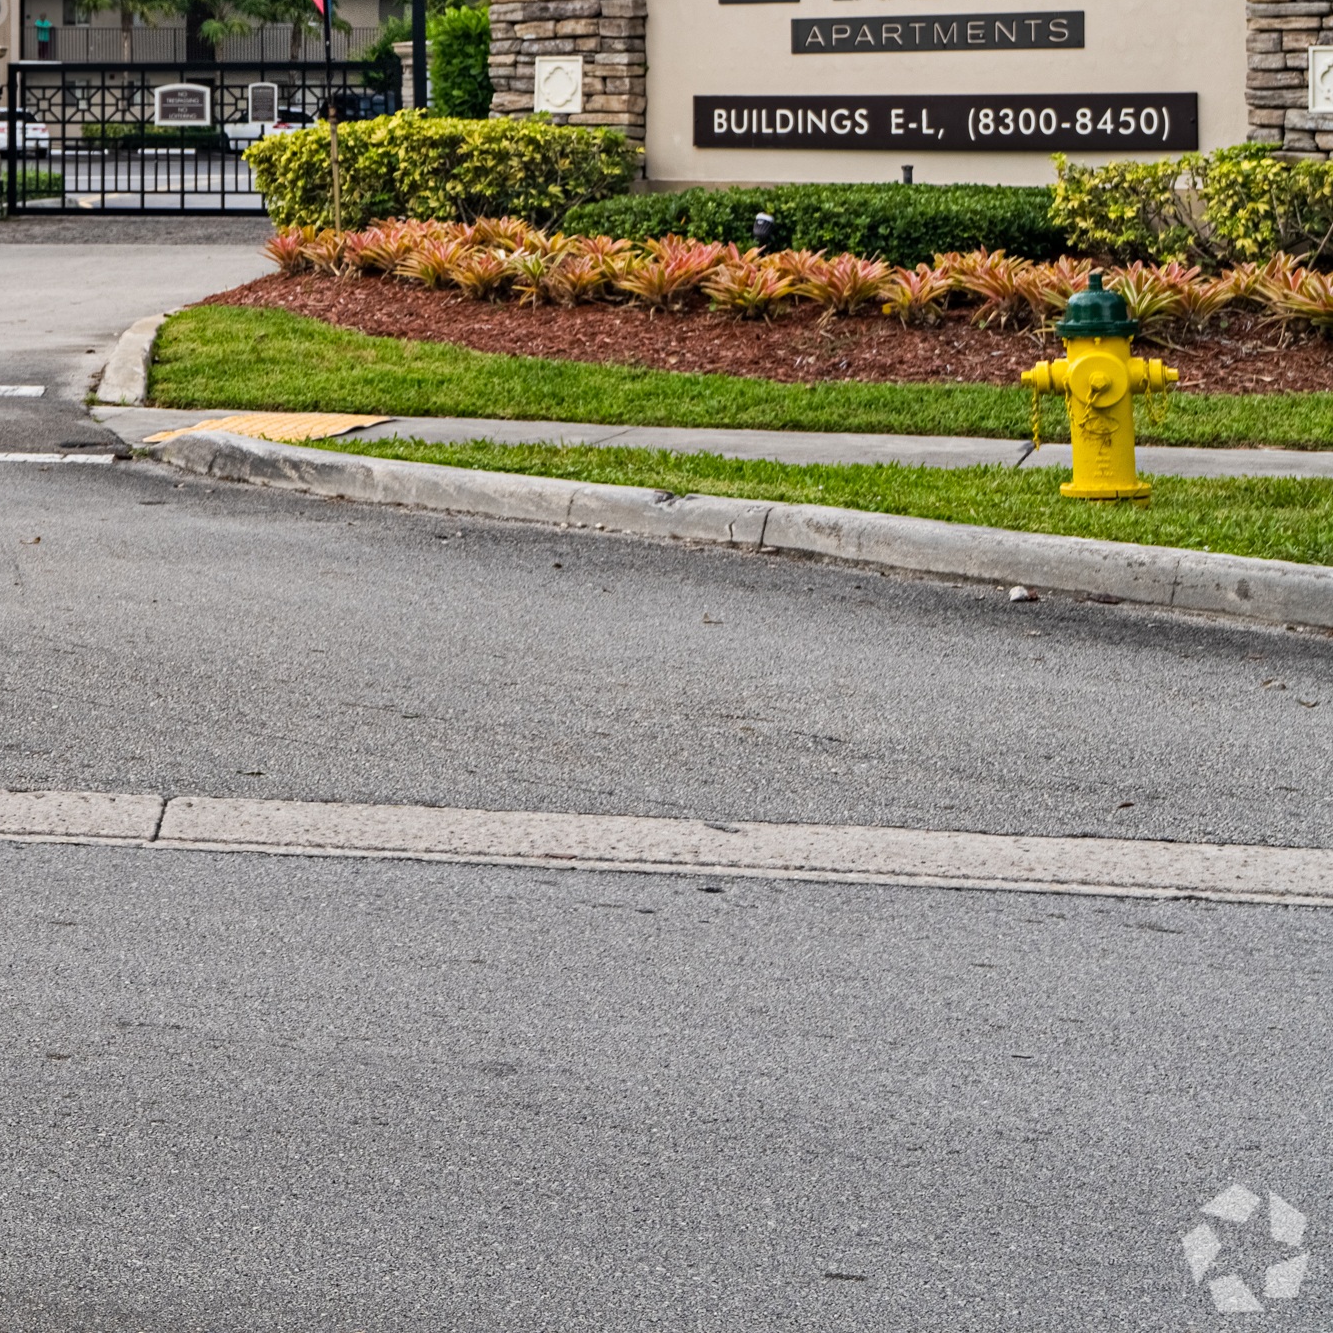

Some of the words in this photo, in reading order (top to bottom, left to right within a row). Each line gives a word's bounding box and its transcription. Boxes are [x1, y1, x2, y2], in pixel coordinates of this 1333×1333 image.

[804, 17, 1070, 48] APARTMENTS
[168, 112, 197, 120] LOITERING
[713, 108, 869, 136] BUILDINGS
[890, 108, 945, 140] E-L,
[967, 106, 1171, 141] (8300-8450)
